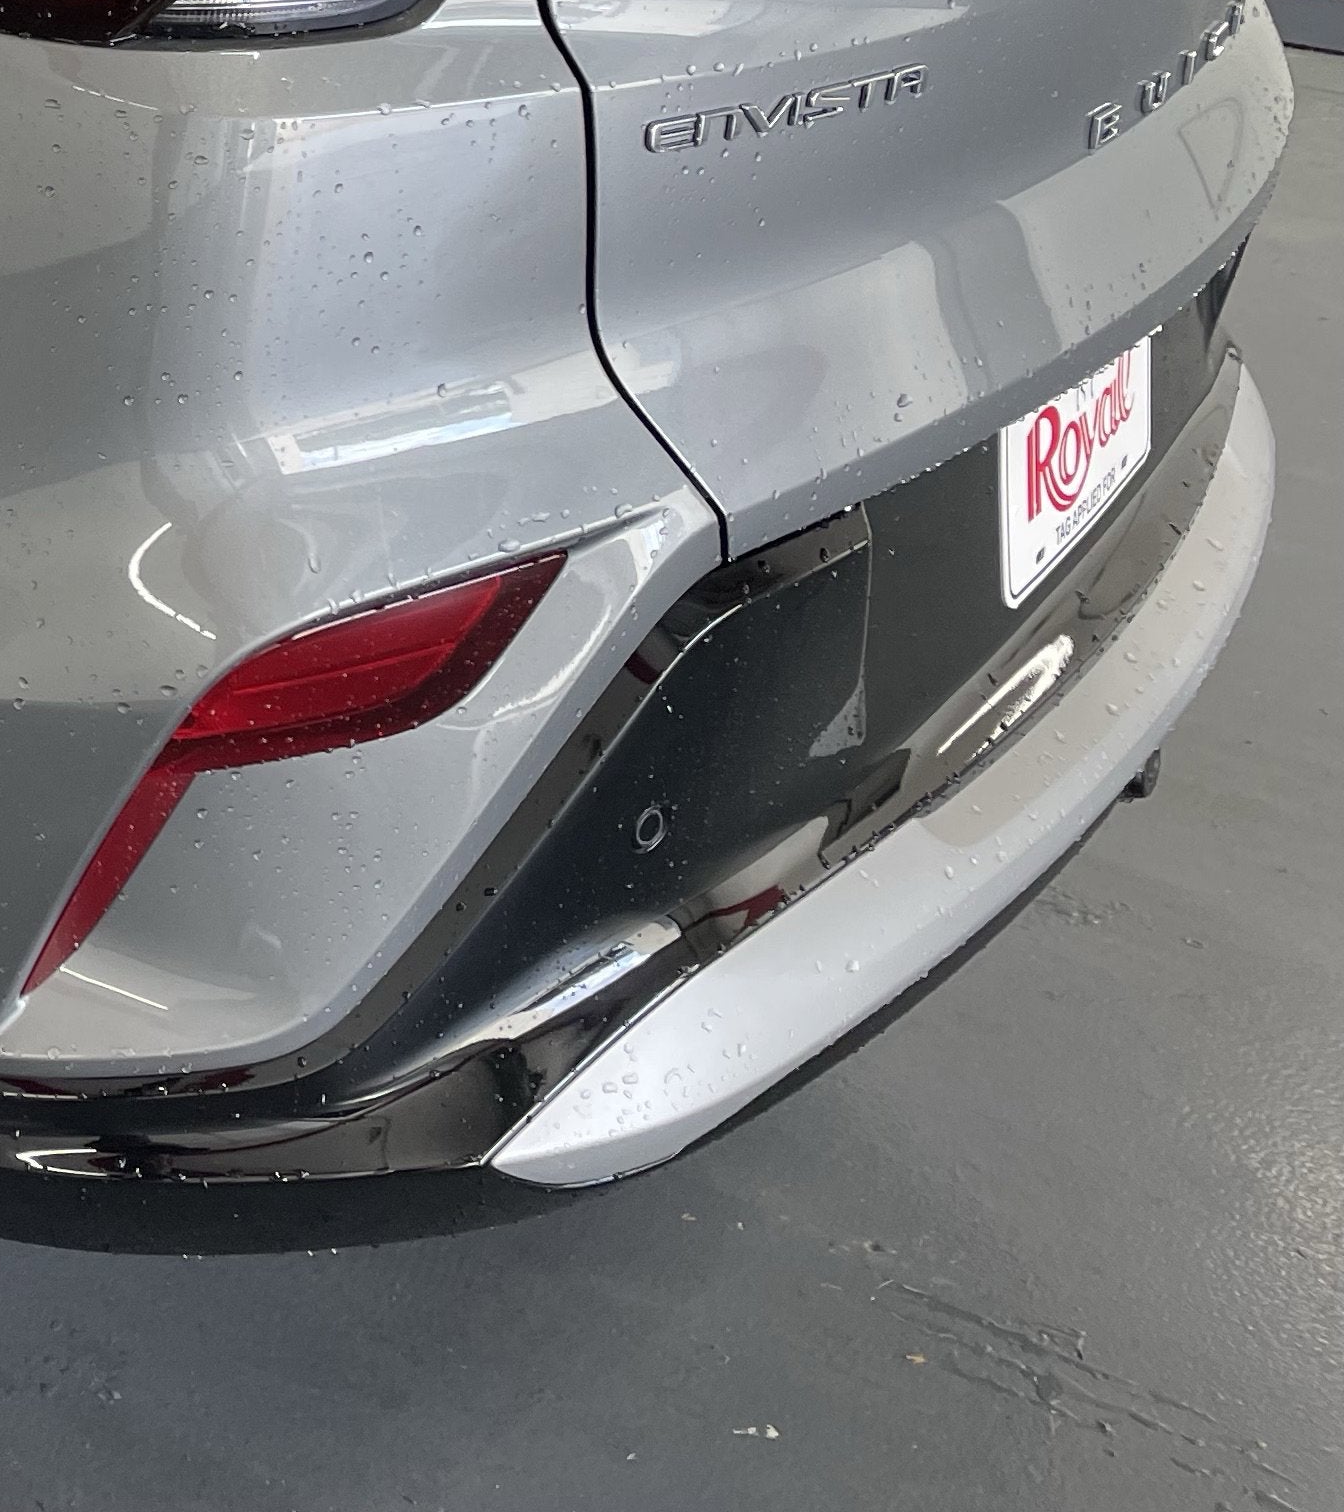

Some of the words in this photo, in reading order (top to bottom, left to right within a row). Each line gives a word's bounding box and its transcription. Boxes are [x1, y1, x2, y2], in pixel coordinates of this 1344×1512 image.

[644, 62, 930, 155] ENVISTA
[1027, 349, 1135, 523] Royal
[1055, 516, 1072, 546] TAG
[1071, 483, 1102, 531] APPLIED
[1103, 467, 1116, 496] FOR
